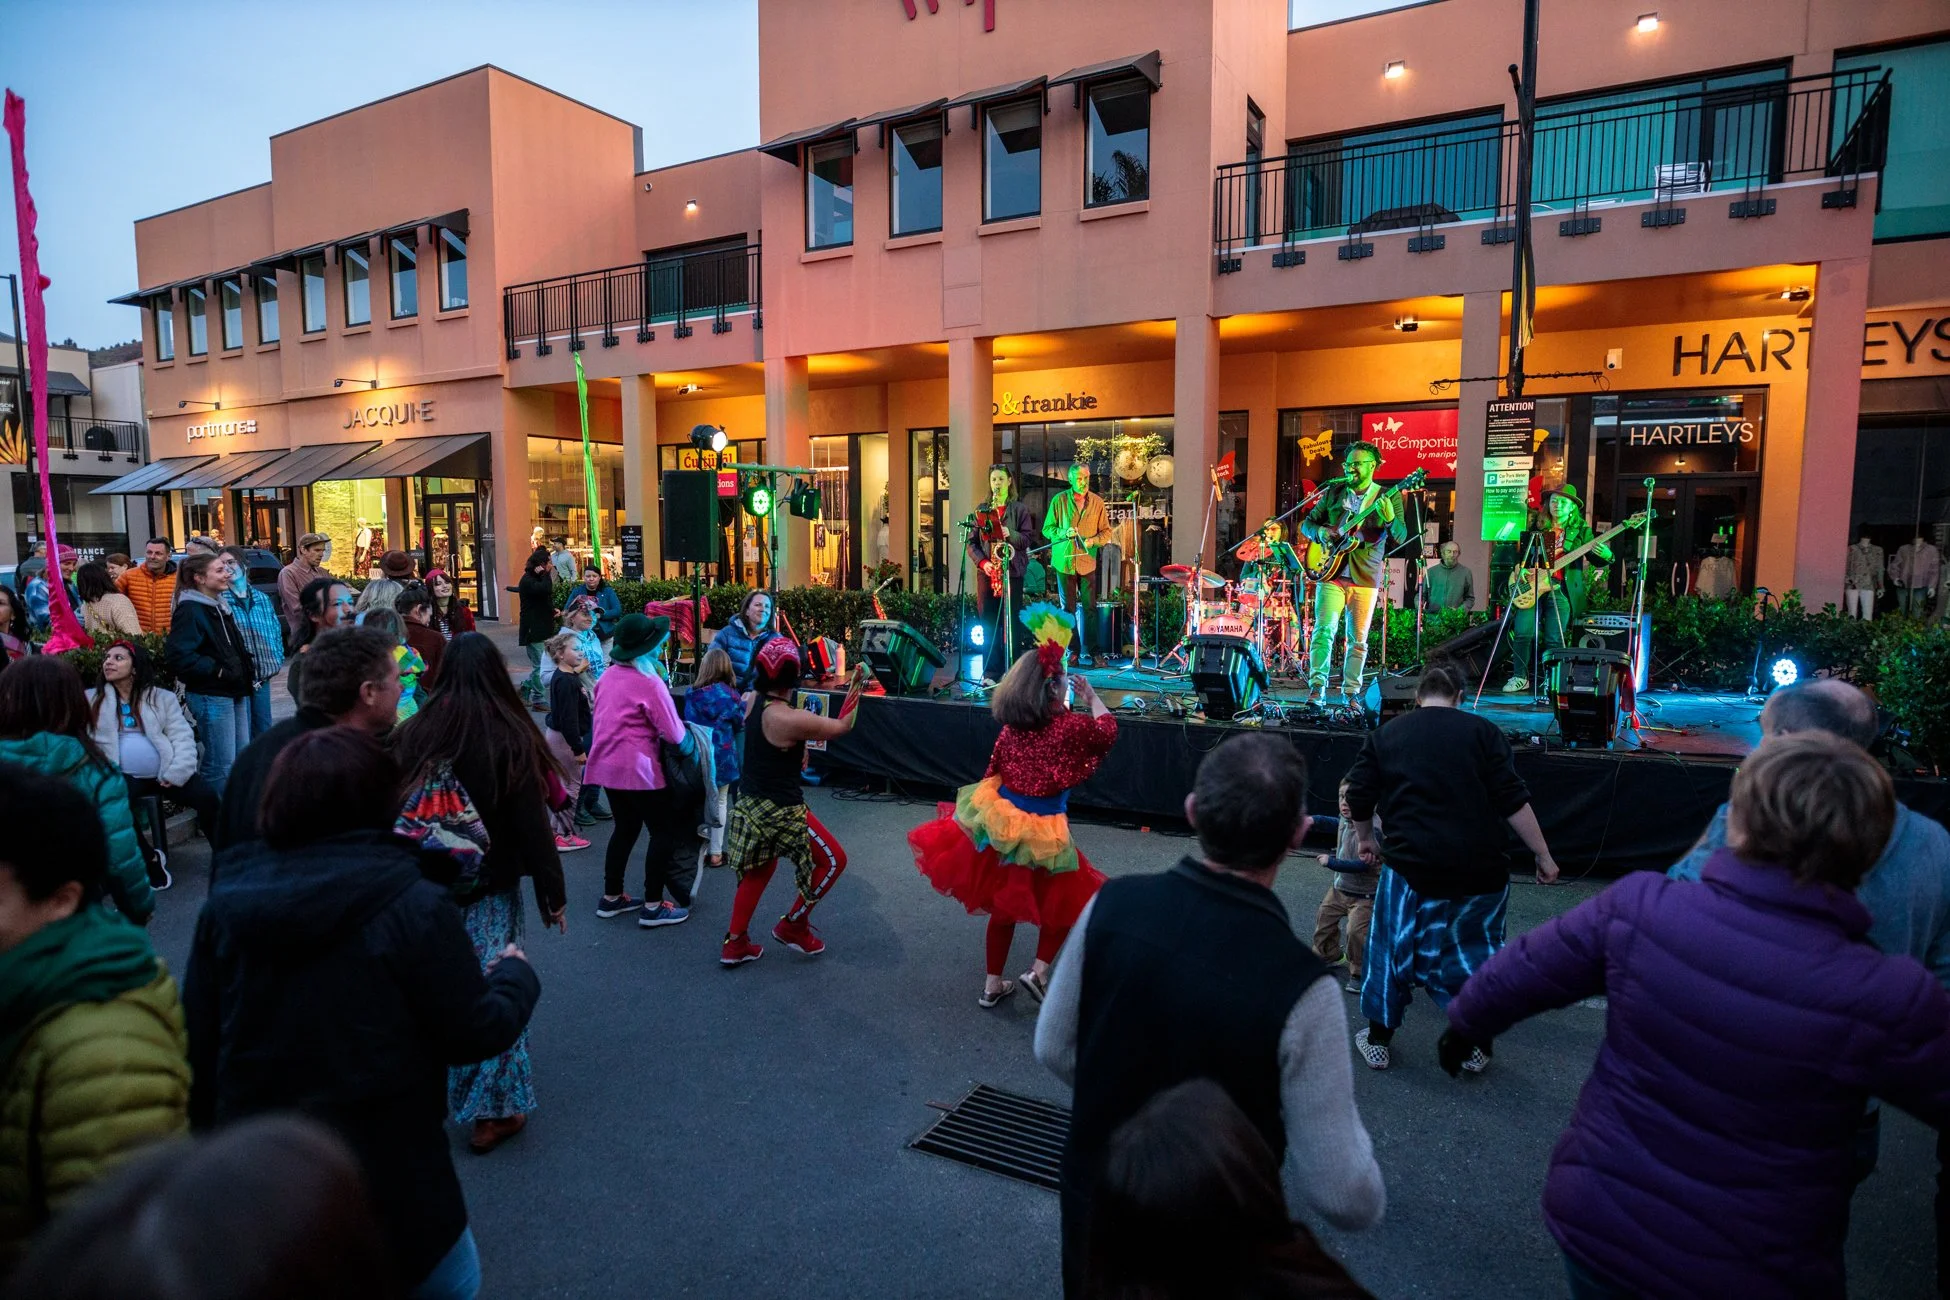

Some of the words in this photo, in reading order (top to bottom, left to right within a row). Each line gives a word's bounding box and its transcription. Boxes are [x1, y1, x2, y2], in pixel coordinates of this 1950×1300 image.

[1002, 391, 1020, 415] &
[1021, 391, 1098, 414] frankie
[1489, 402, 1534, 412] ATTENTION
[187, 421, 248, 444] portmans
[1630, 422, 1754, 446] HARTLEYS
[1303, 439, 1330, 451] Fabulous
[1372, 436, 1397, 450] The
[1309, 446, 1326, 455] Deals
[1417, 451, 1427, 459] by
[1216, 625, 1243, 633] YAMAHA
